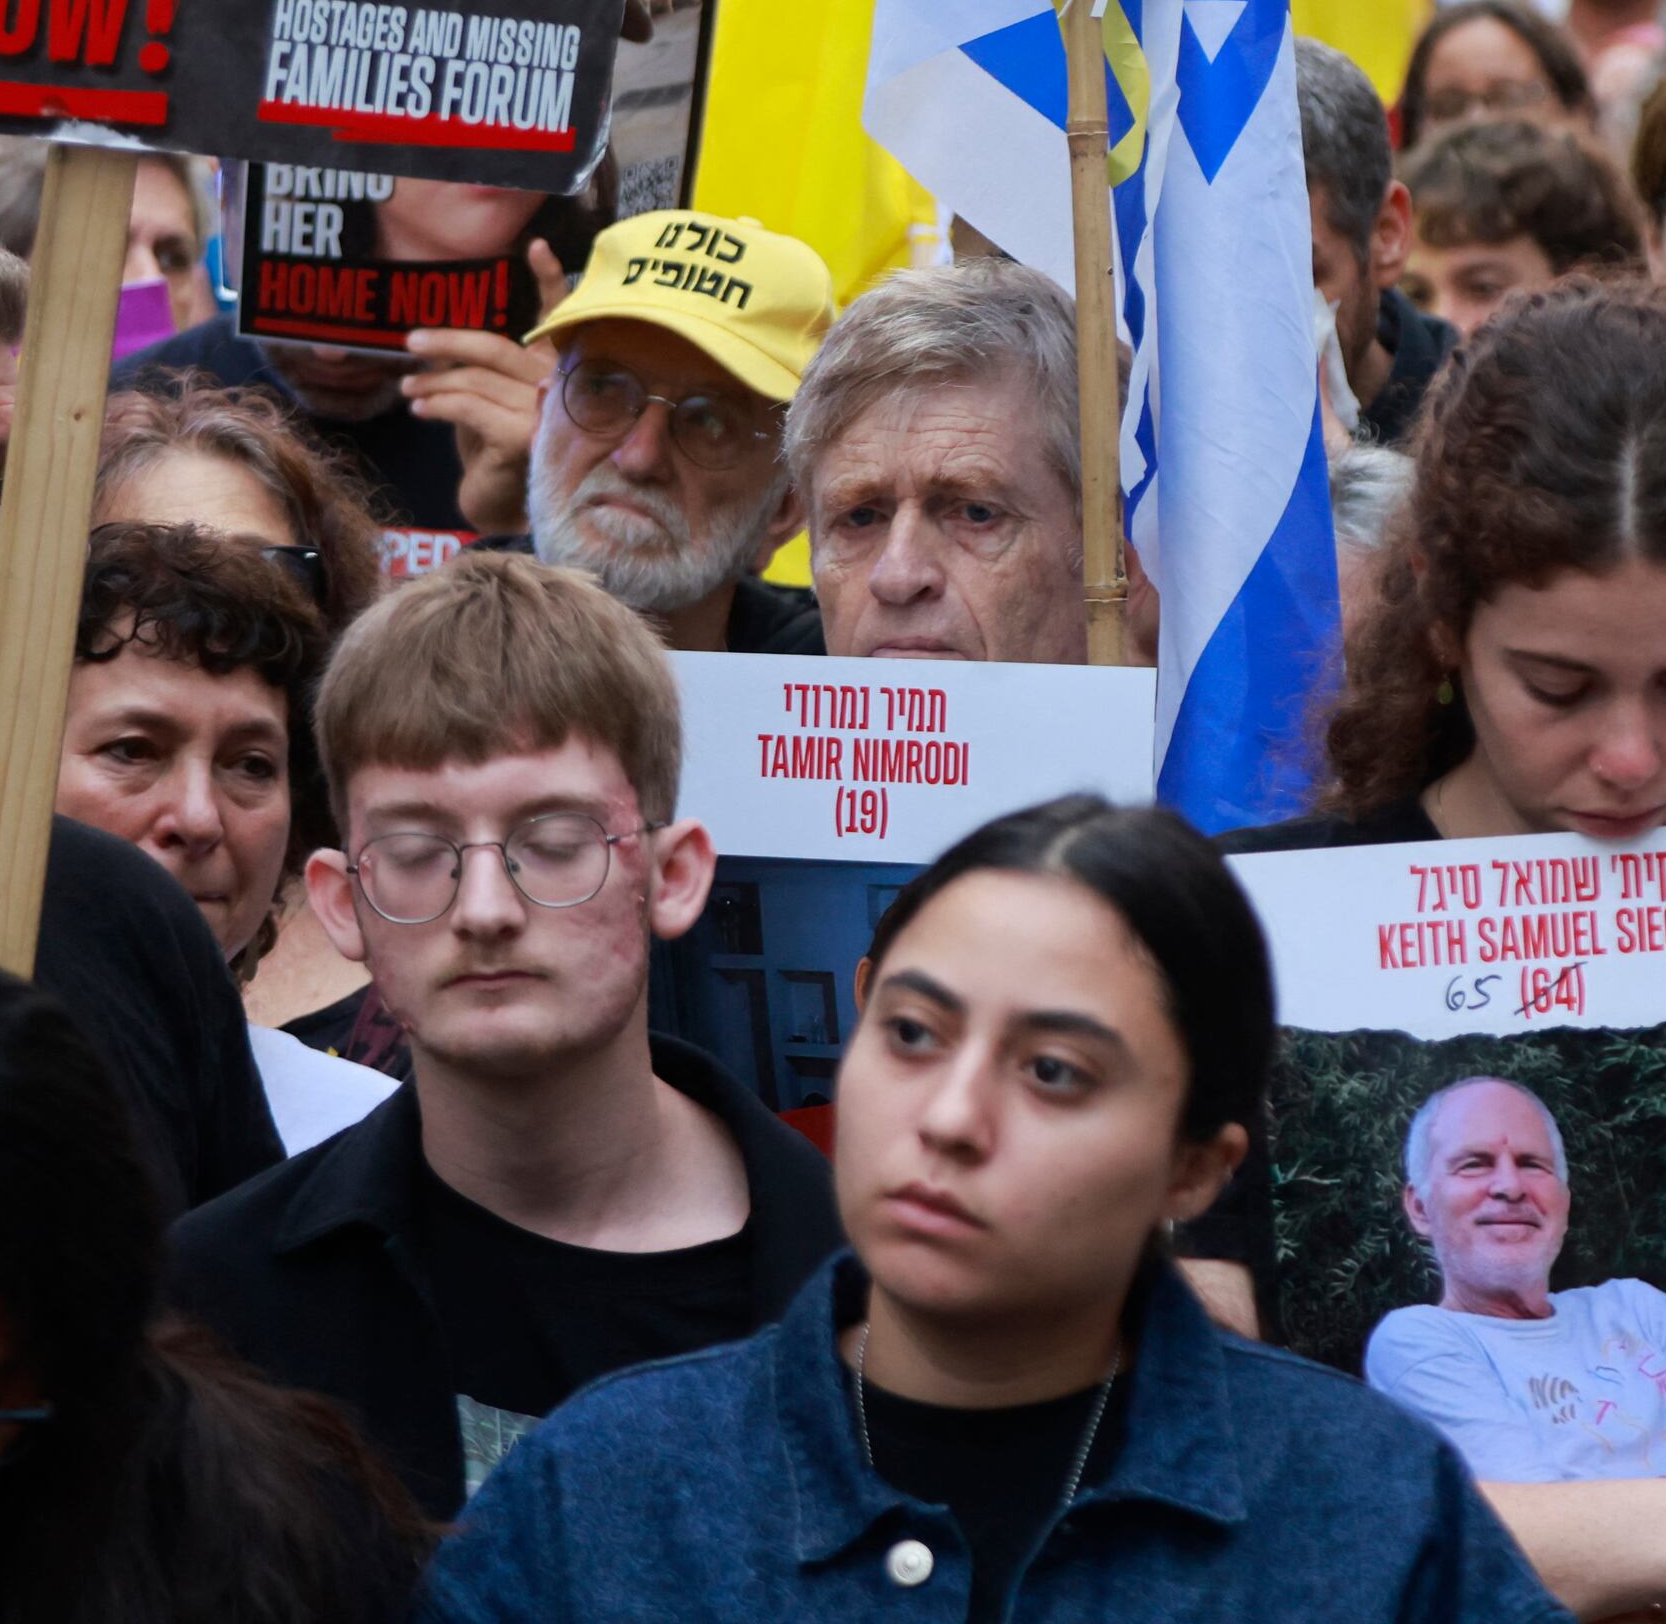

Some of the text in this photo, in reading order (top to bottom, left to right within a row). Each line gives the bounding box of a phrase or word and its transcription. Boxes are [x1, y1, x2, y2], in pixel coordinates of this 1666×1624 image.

[408, 8, 465, 58] AND
[465, 14, 581, 71] MISSING
[265, 40, 577, 134] FAMILIES FORUM
[261, 201, 345, 259] HER
[654, 221, 748, 265] כולנו
[259, 259, 511, 328] HOME NOW!
[782, 682, 948, 734] תמיר נמרודי
[757, 734, 970, 787] TAMIR NIMRODI
[834, 785, 889, 840] (19)
[1409, 862, 1483, 914] סיגל
[1492, 855, 1602, 909] שמואל
[1376, 919, 1469, 971] KEITH
[1477, 911, 1608, 964] SAMUEL
[1445, 974, 1502, 1012] 65
